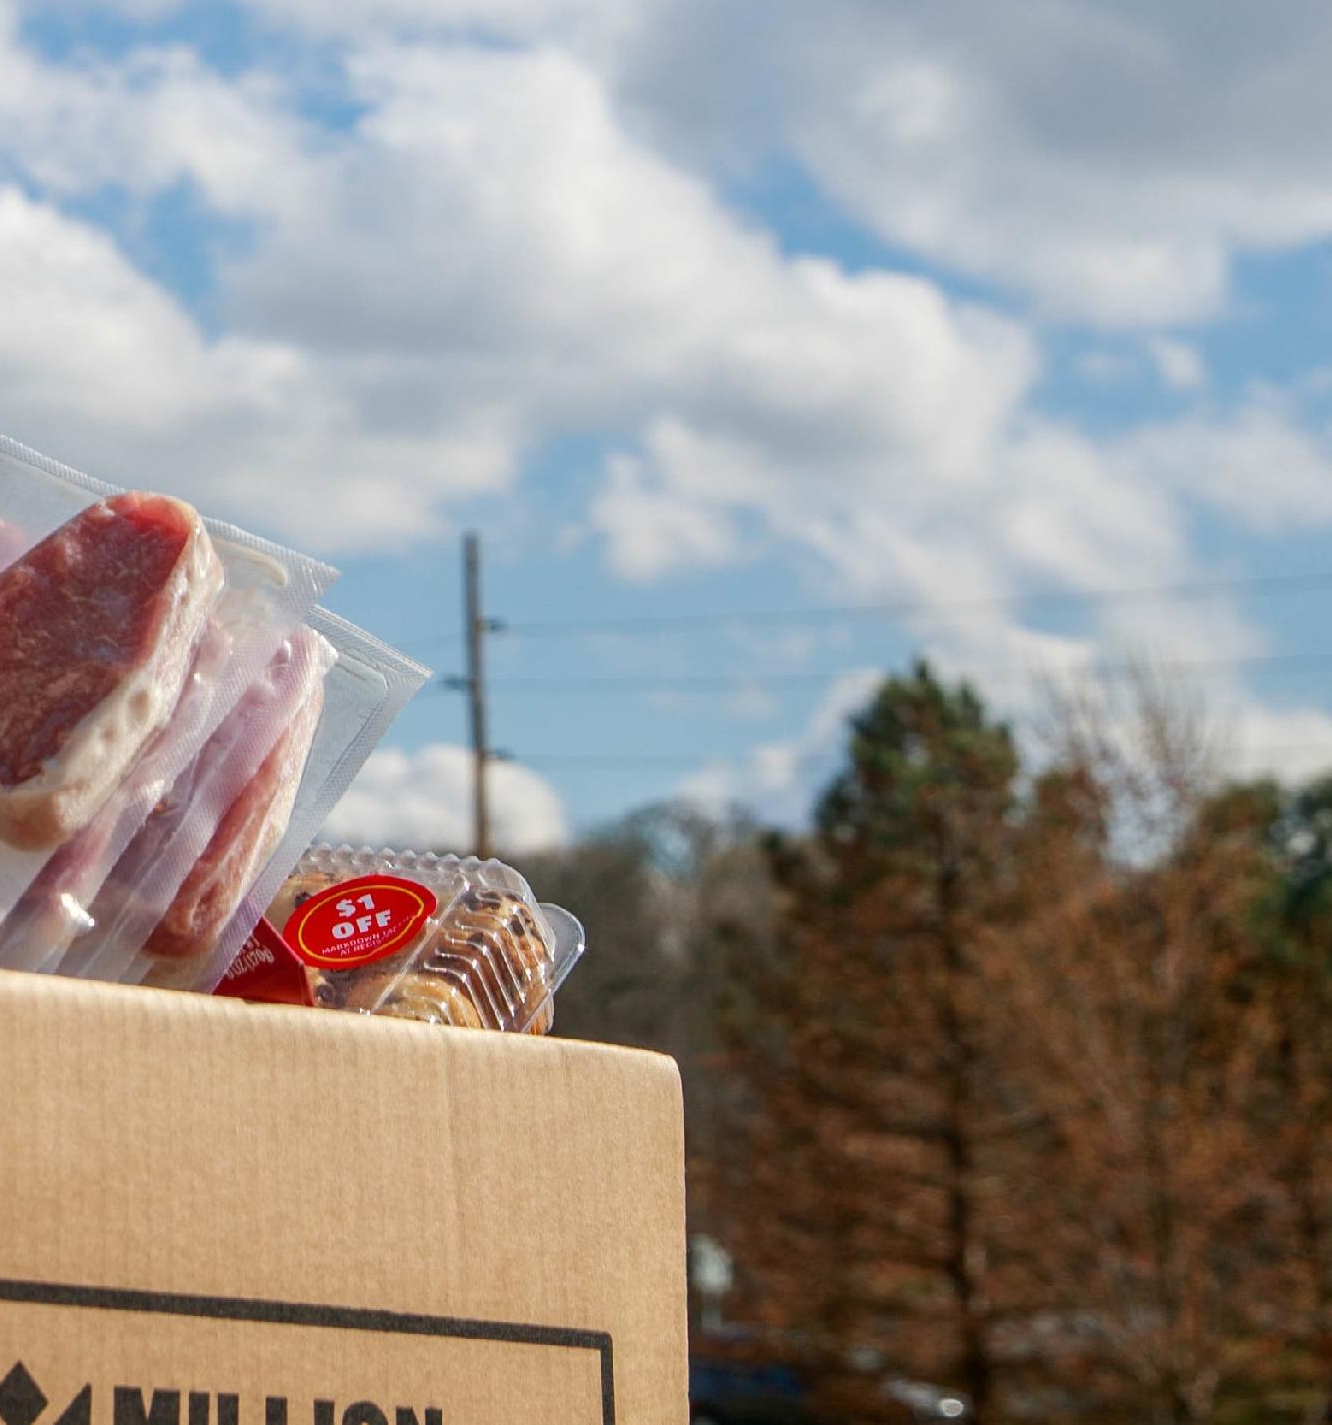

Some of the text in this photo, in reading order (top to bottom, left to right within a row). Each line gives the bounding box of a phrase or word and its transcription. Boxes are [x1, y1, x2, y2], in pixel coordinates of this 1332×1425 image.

[336, 893, 375, 918] $1
[331, 909, 391, 939] OFF
[322, 932, 380, 955] MARKDOWN
